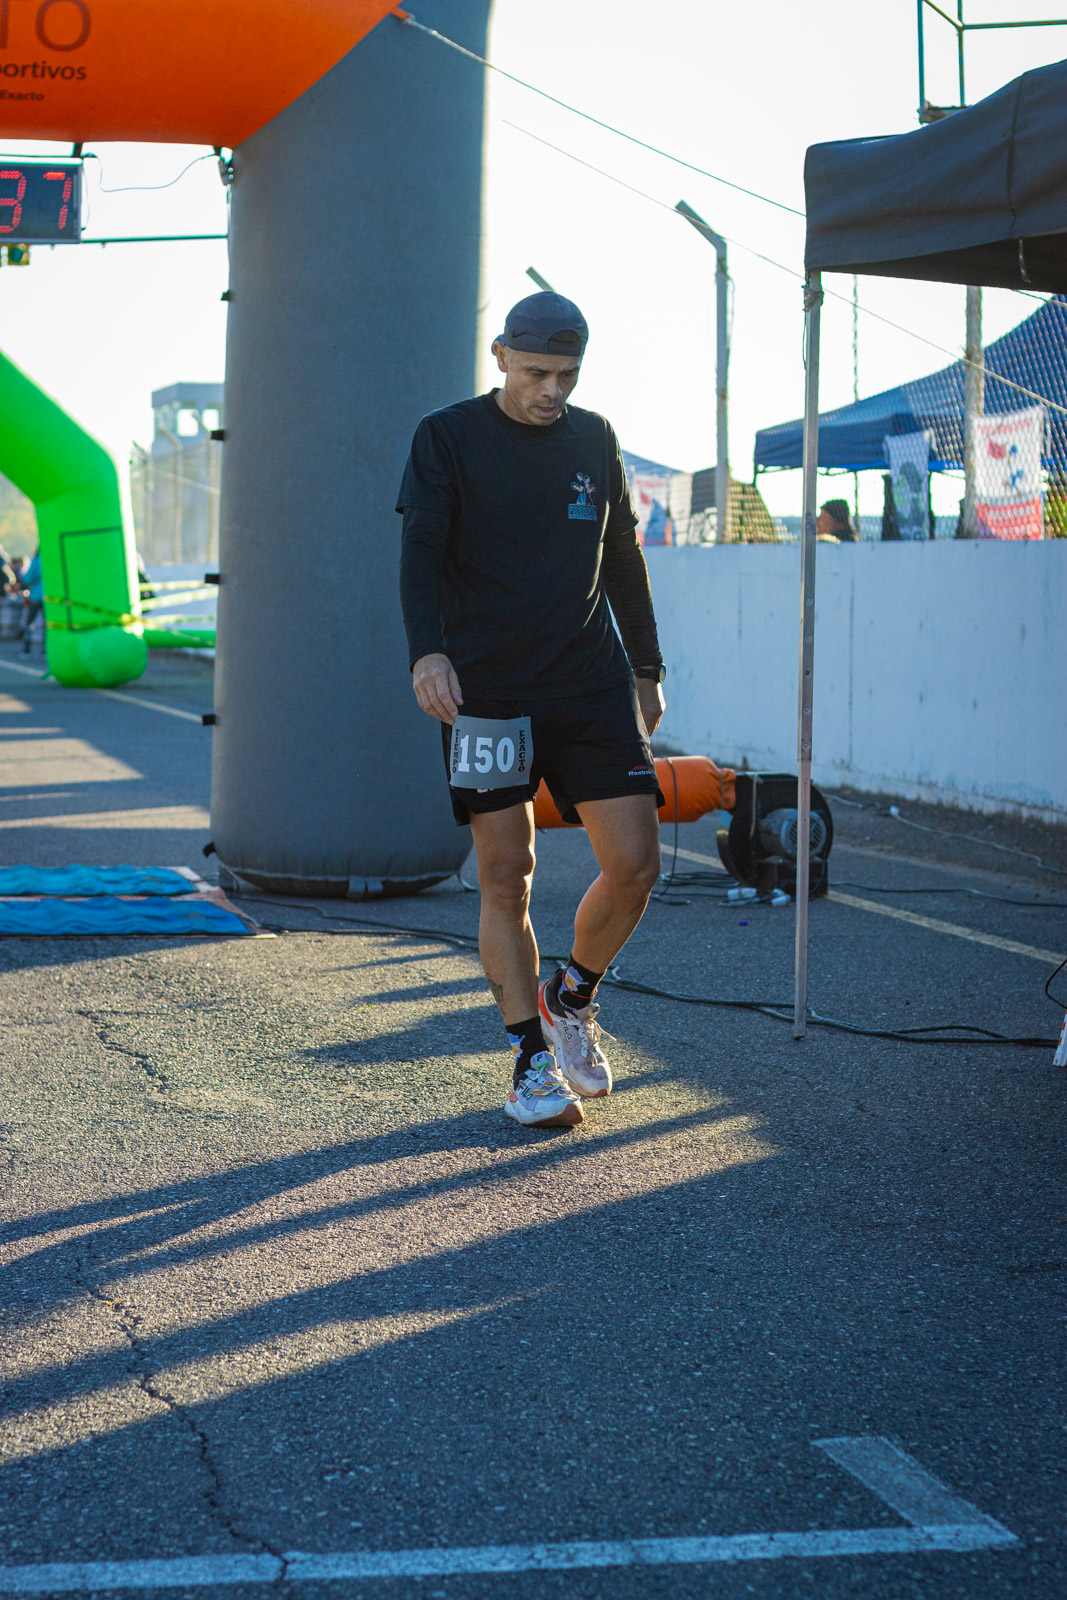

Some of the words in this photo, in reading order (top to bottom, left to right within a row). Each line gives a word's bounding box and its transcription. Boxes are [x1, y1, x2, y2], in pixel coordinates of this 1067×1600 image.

[0, 60, 87, 80] ortivos
[452, 728, 460, 773] TIEMPO
[457, 734, 515, 774] 150
[518, 729, 526, 773] EXACTO
[559, 1019, 574, 1041] FILA
